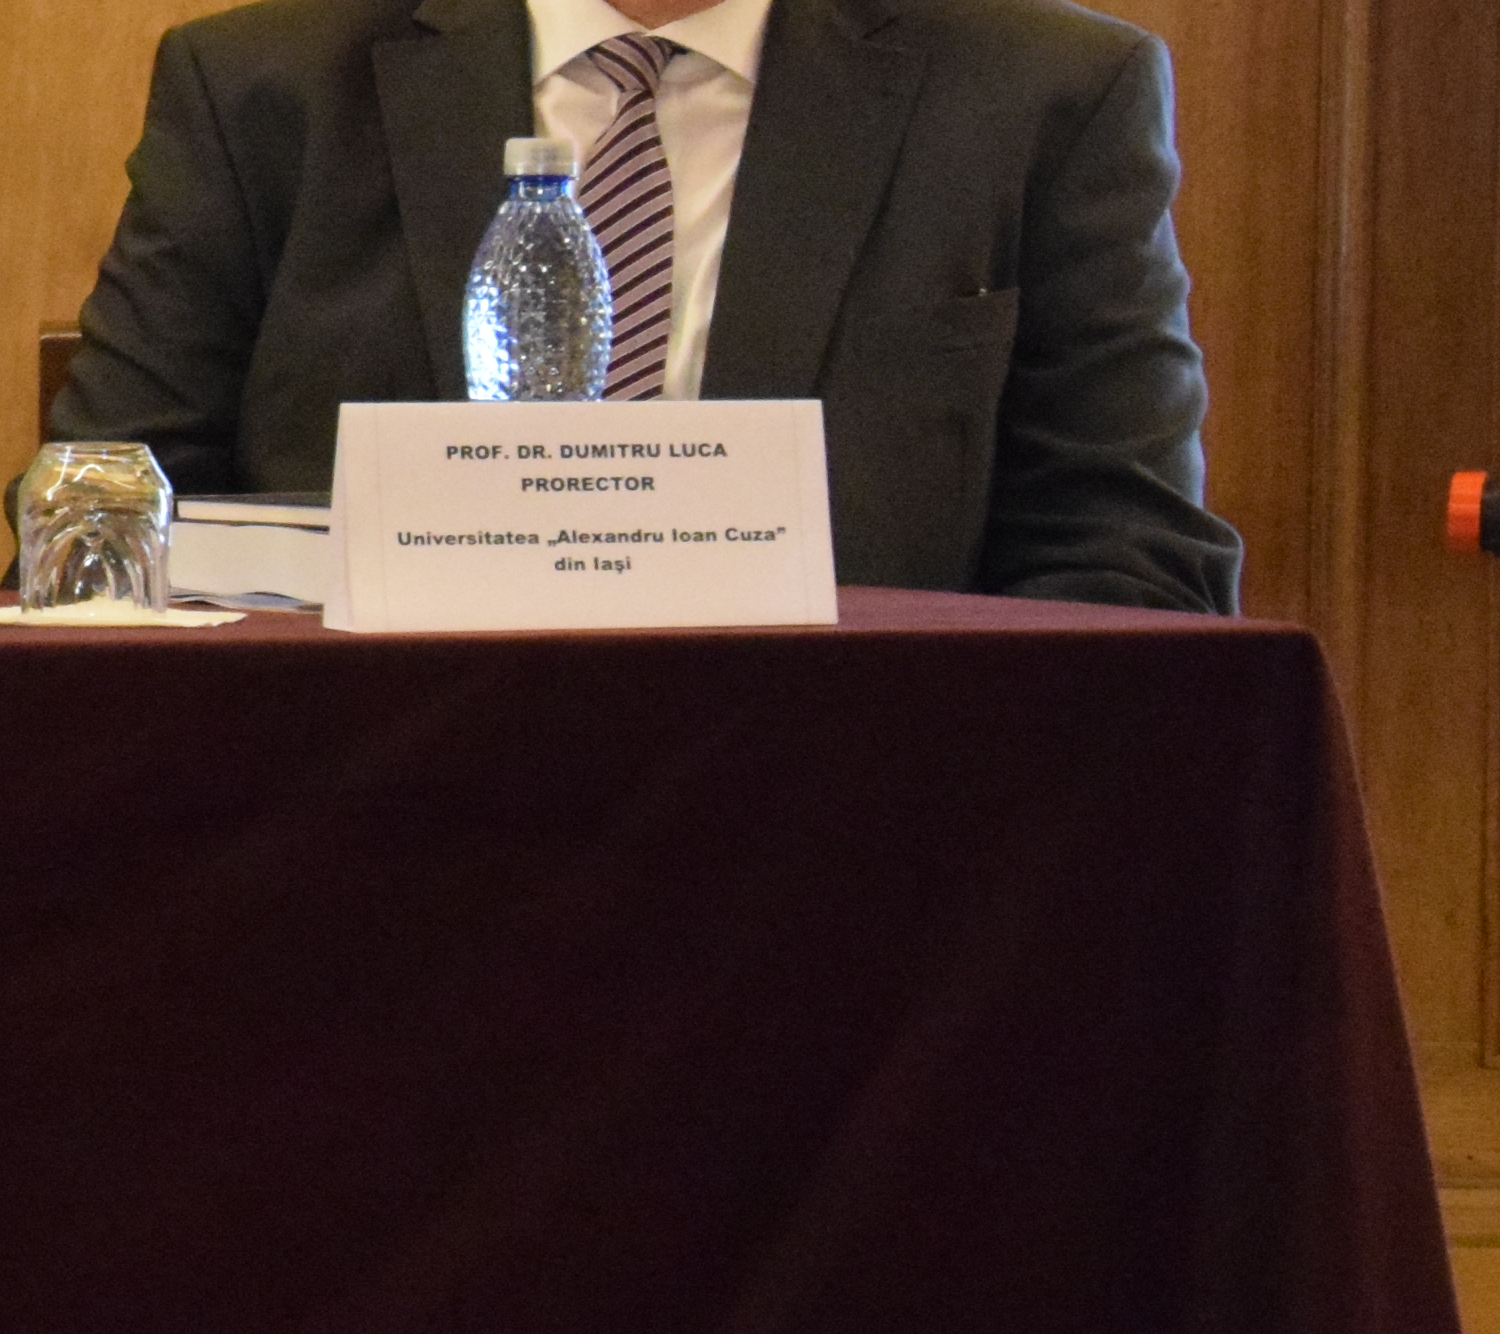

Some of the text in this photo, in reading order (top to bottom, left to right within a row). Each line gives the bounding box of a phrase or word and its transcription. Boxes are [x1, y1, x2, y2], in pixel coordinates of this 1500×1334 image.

[444, 441, 729, 462] PROF. DR. DUMITRU LUCA
[519, 475, 657, 494] PRORECTOR
[395, 529, 541, 548] Universitatea
[670, 526, 719, 544] Ioan
[553, 555, 588, 573] din
